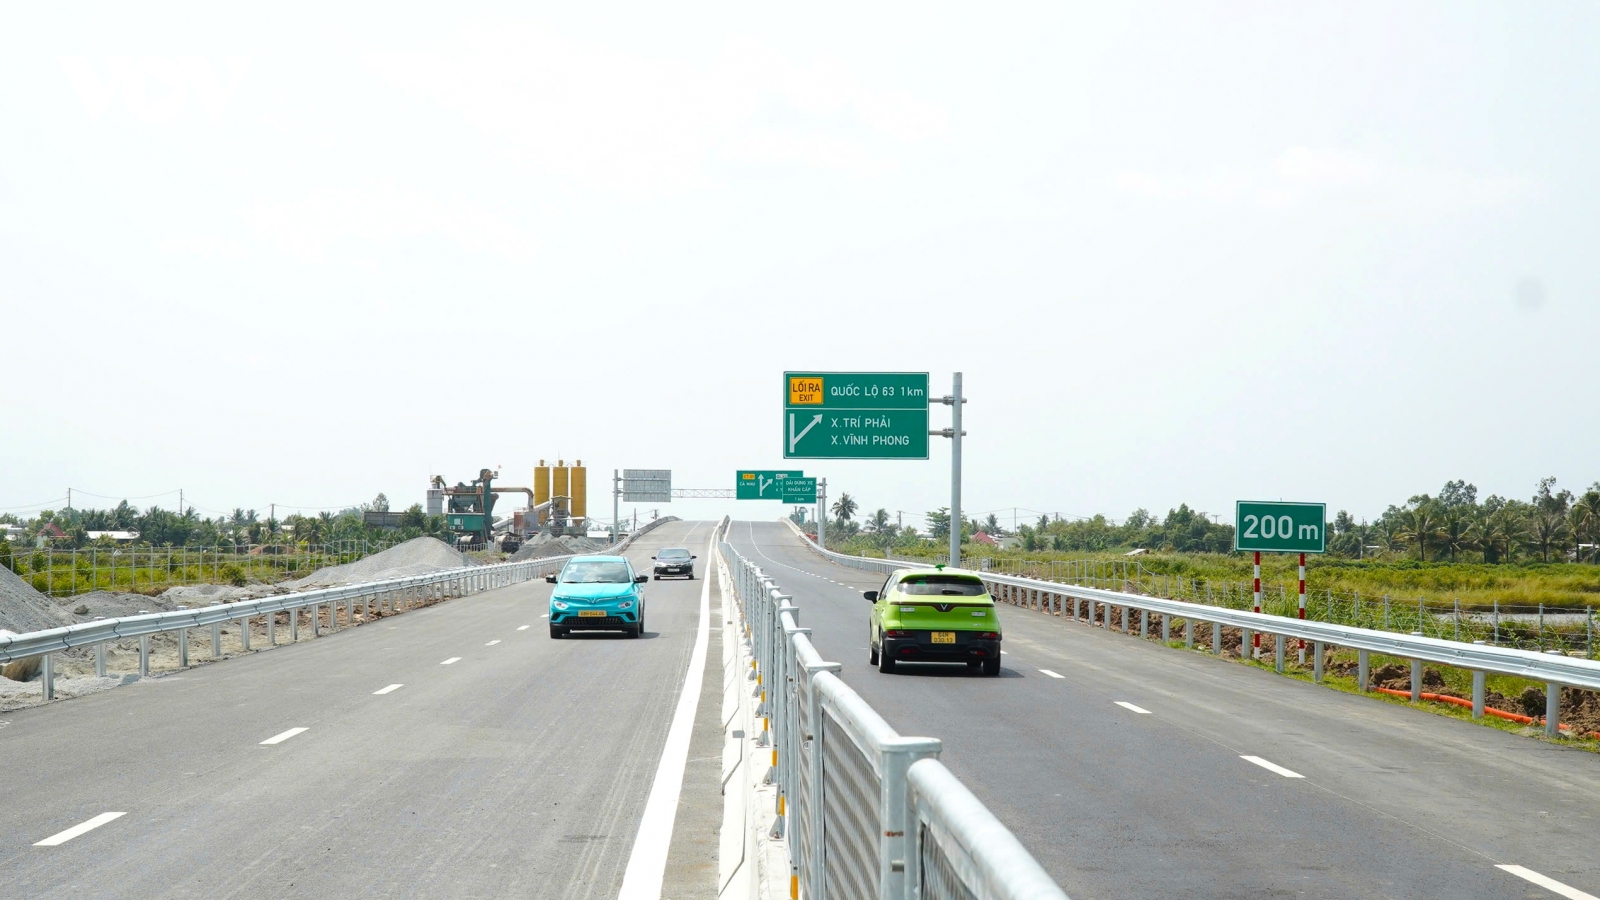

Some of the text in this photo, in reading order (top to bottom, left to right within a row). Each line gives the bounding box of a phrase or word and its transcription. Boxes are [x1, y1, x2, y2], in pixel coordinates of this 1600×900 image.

[792, 380, 821, 393] LỐI RA
[831, 383, 860, 397] QUỐC
[864, 384, 879, 399] LỘ
[882, 386, 895, 397] 63
[799, 394, 813, 402] EXIT
[864, 415, 891, 428] PHẢI
[872, 435, 910, 446] PHONG
